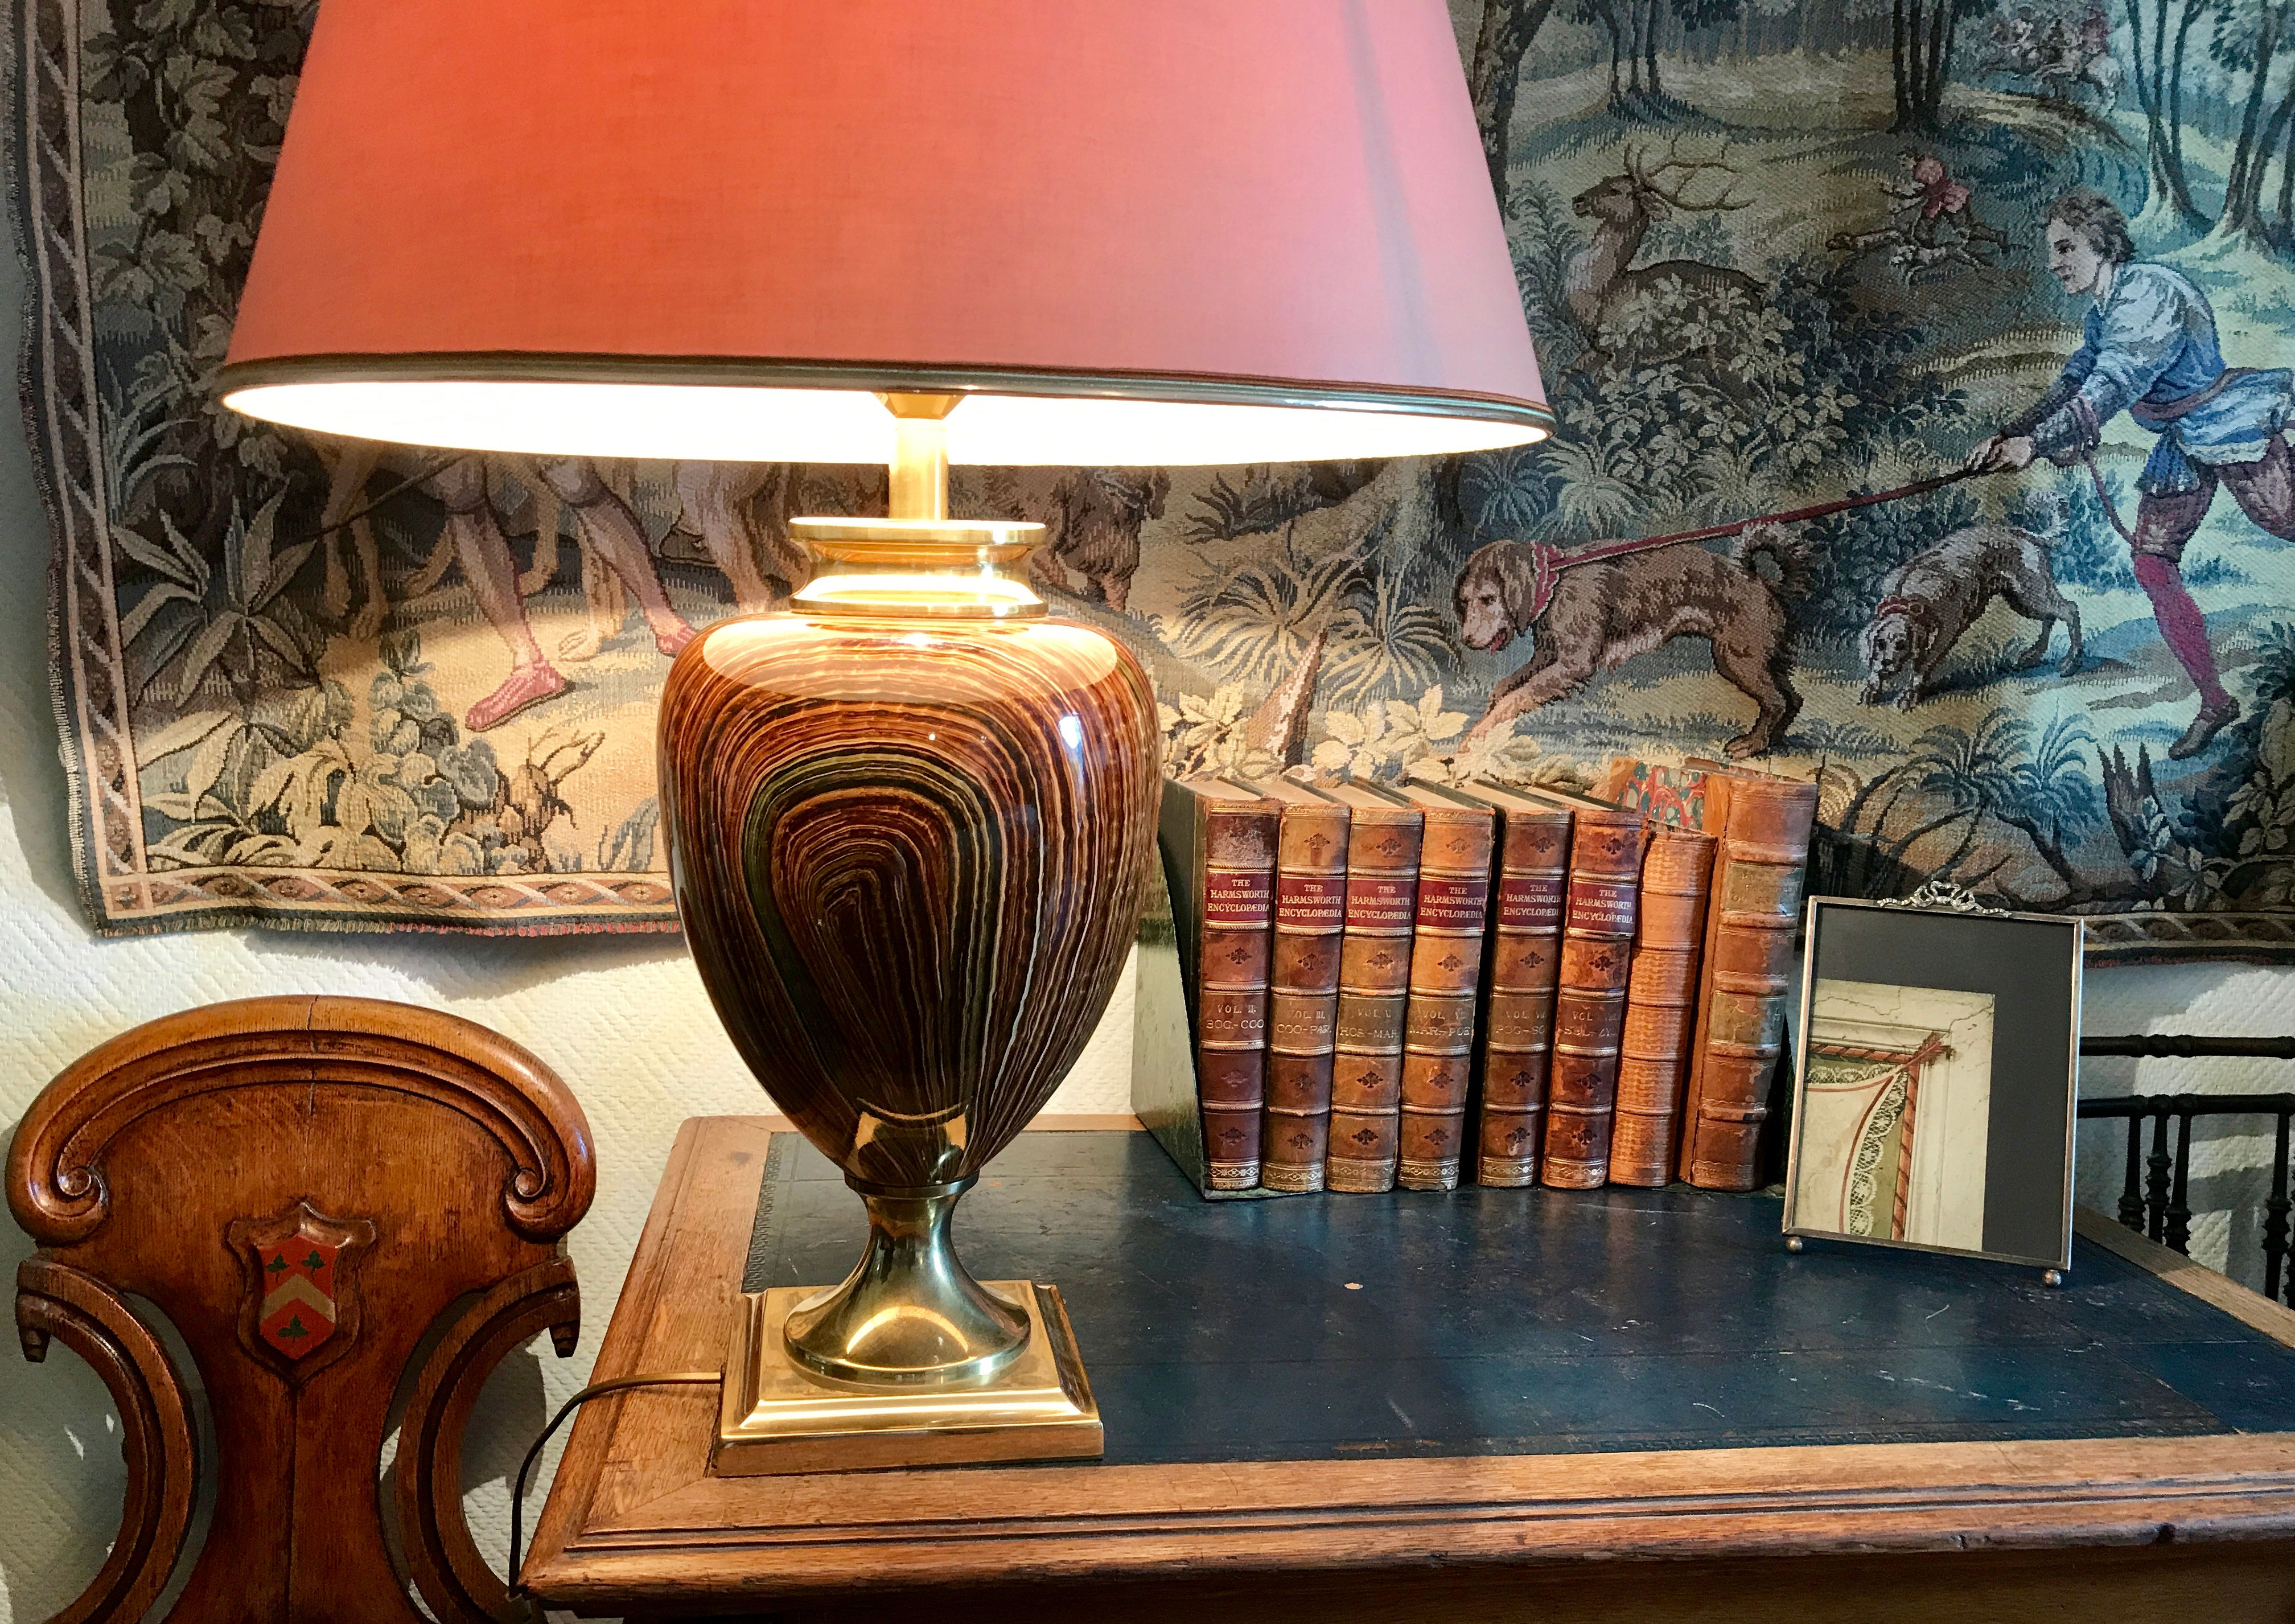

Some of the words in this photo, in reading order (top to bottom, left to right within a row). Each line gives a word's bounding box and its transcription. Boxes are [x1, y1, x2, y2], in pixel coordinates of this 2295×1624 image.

[1210, 889, 1269, 899] HARMSWORTH
[1507, 894, 1561, 903] HARMSWORTH
[1599, 889, 1617, 898] THE
[1282, 895, 1340, 905] HARMSWORTH
[1351, 896, 1410, 906] HARMSWORTH
[1424, 895, 1483, 906] HARMSWORTH
[1576, 897, 1632, 910] HARMSWORTH
[1207, 903, 1269, 912] ENCYCLOPÆDIA
[1420, 907, 1483, 918] ENCYCLOPÆDIA
[1279, 908, 1342, 918] ENCYCLOPÆDIA
[1348, 910, 1412, 919] ENCYCLOPÆDIA
[1573, 910, 1634, 923] ENCYCLOPÆDIA
